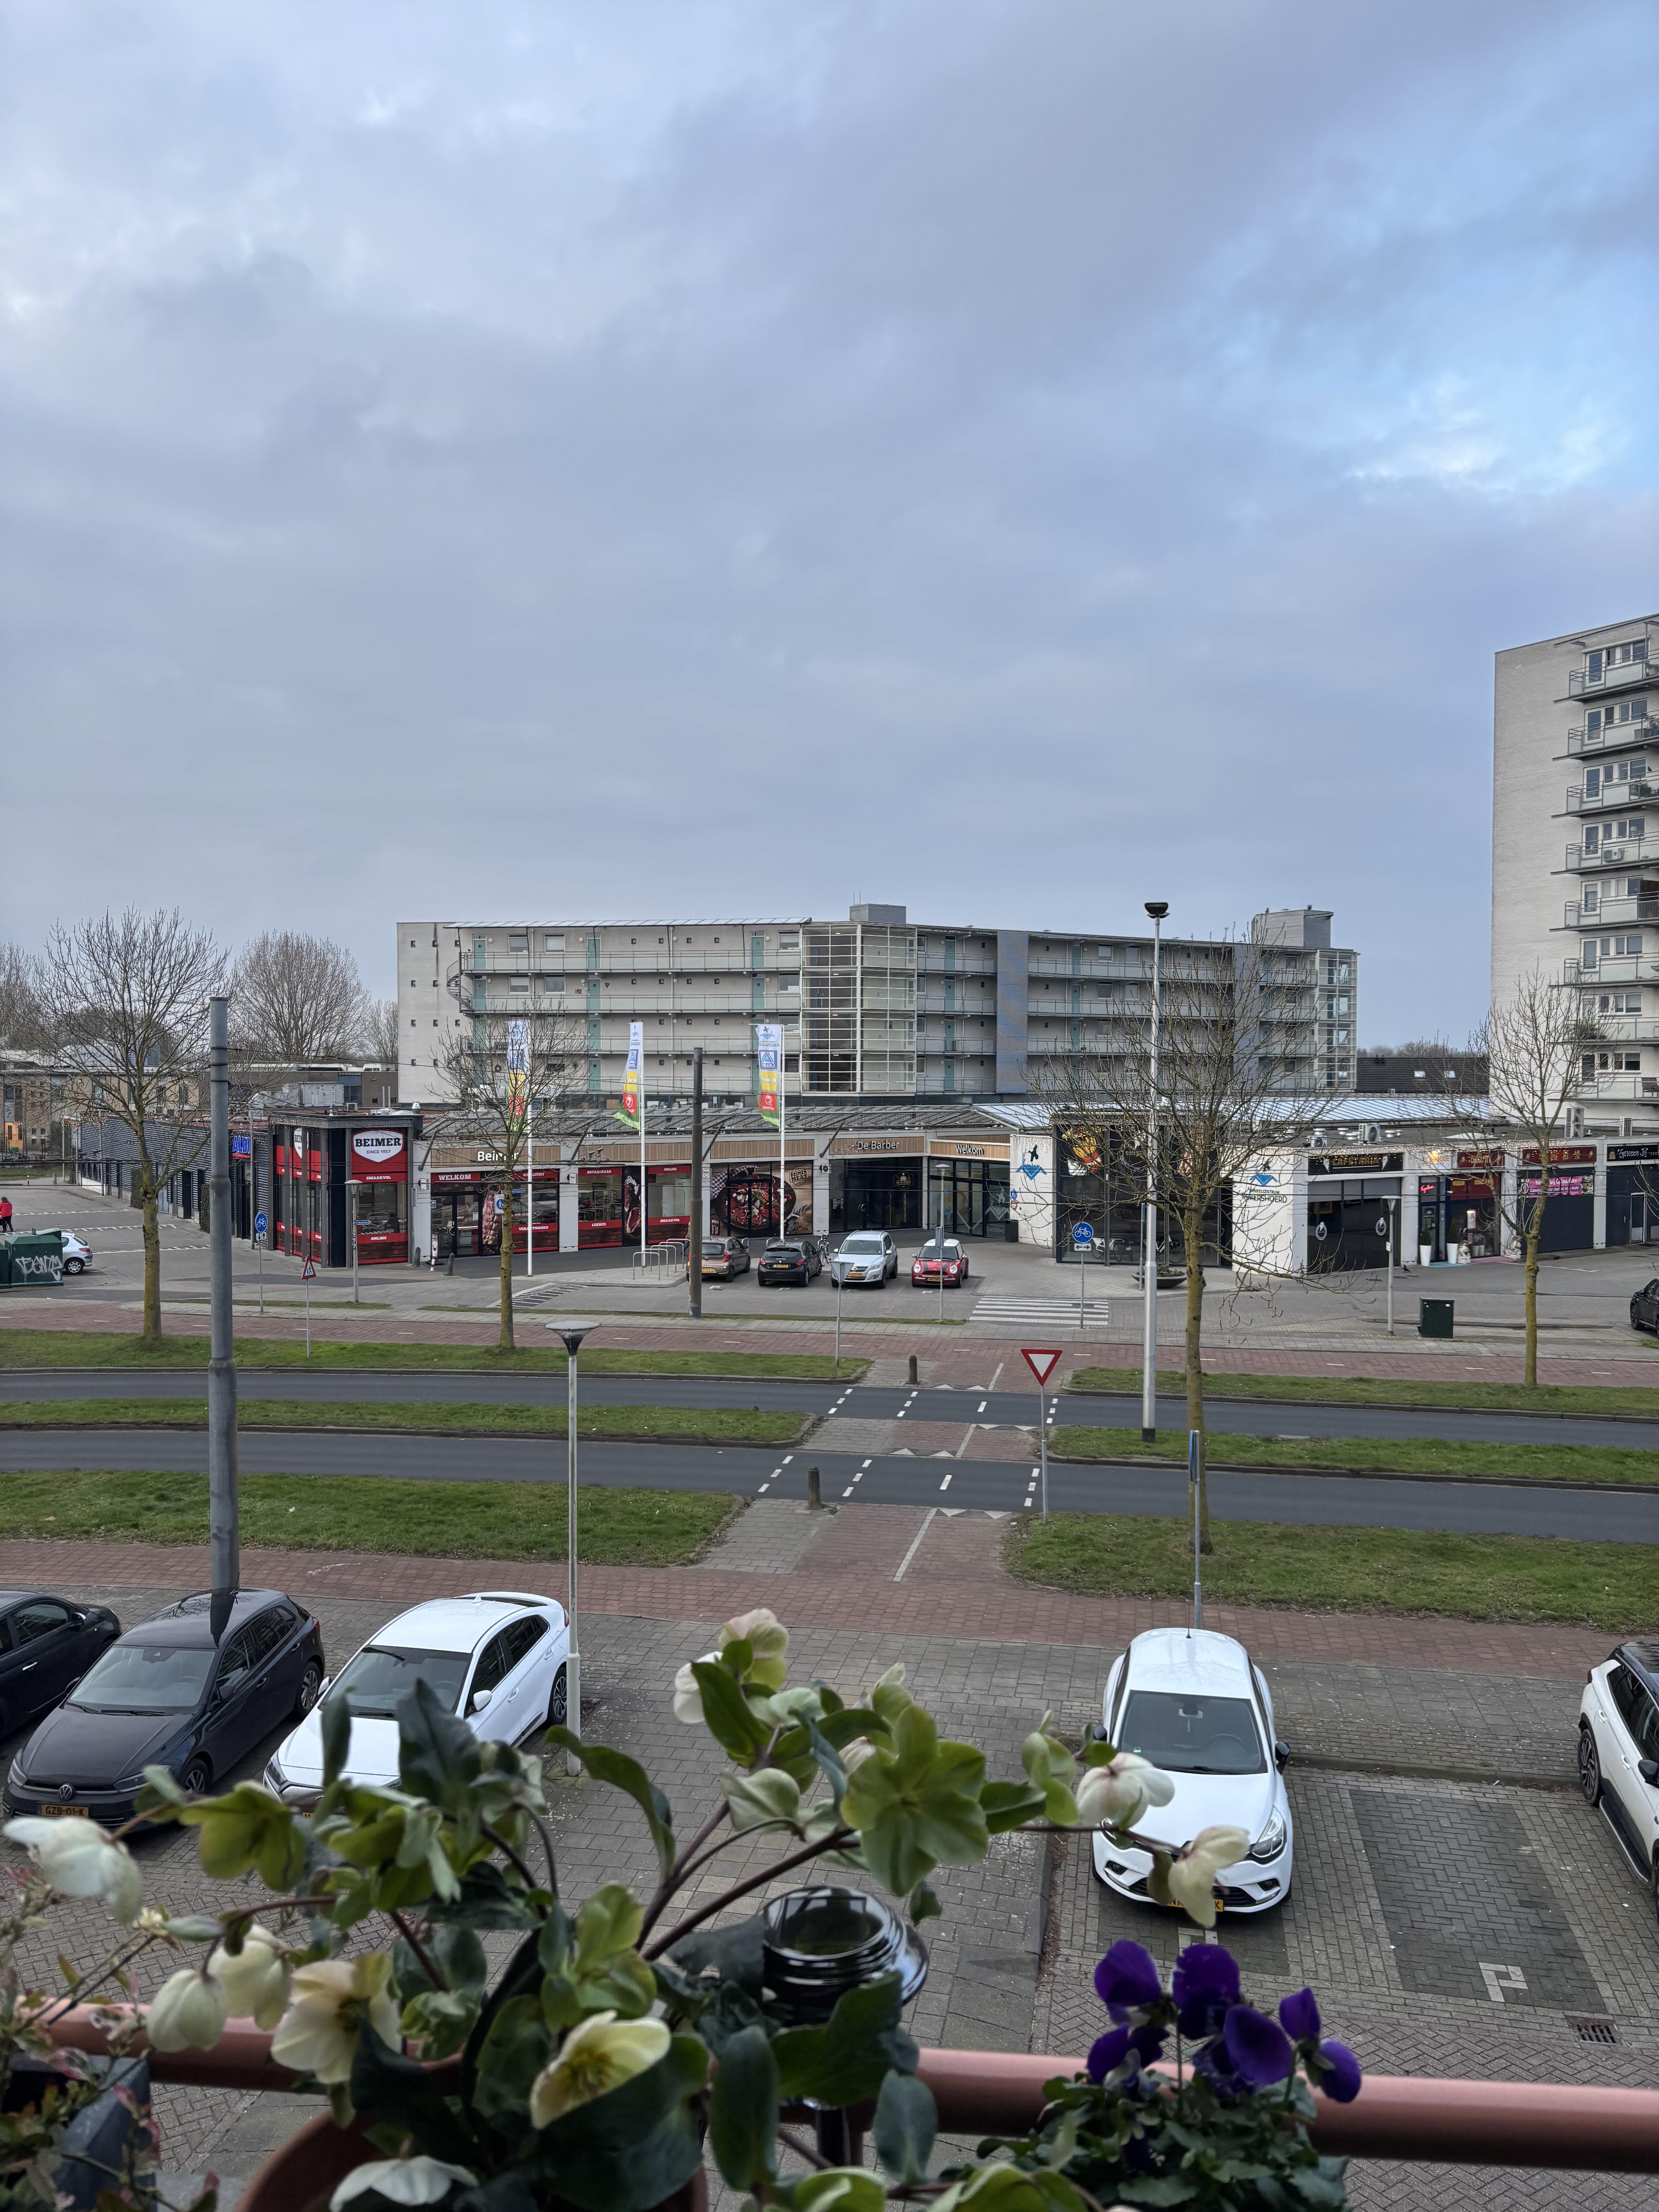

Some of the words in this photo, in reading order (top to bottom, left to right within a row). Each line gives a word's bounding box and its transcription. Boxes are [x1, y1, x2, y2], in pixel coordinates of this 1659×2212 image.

[232, 1135, 250, 1154] ALDI
[355, 1138, 401, 1147] BEIMER
[857, 1142, 868, 1150] De
[871, 1140, 900, 1150] Barber
[955, 1144, 984, 1155] Welkom
[477, 1151, 519, 1161] Beimr
[45, 1806, 84, 1817] GZB-01-K
